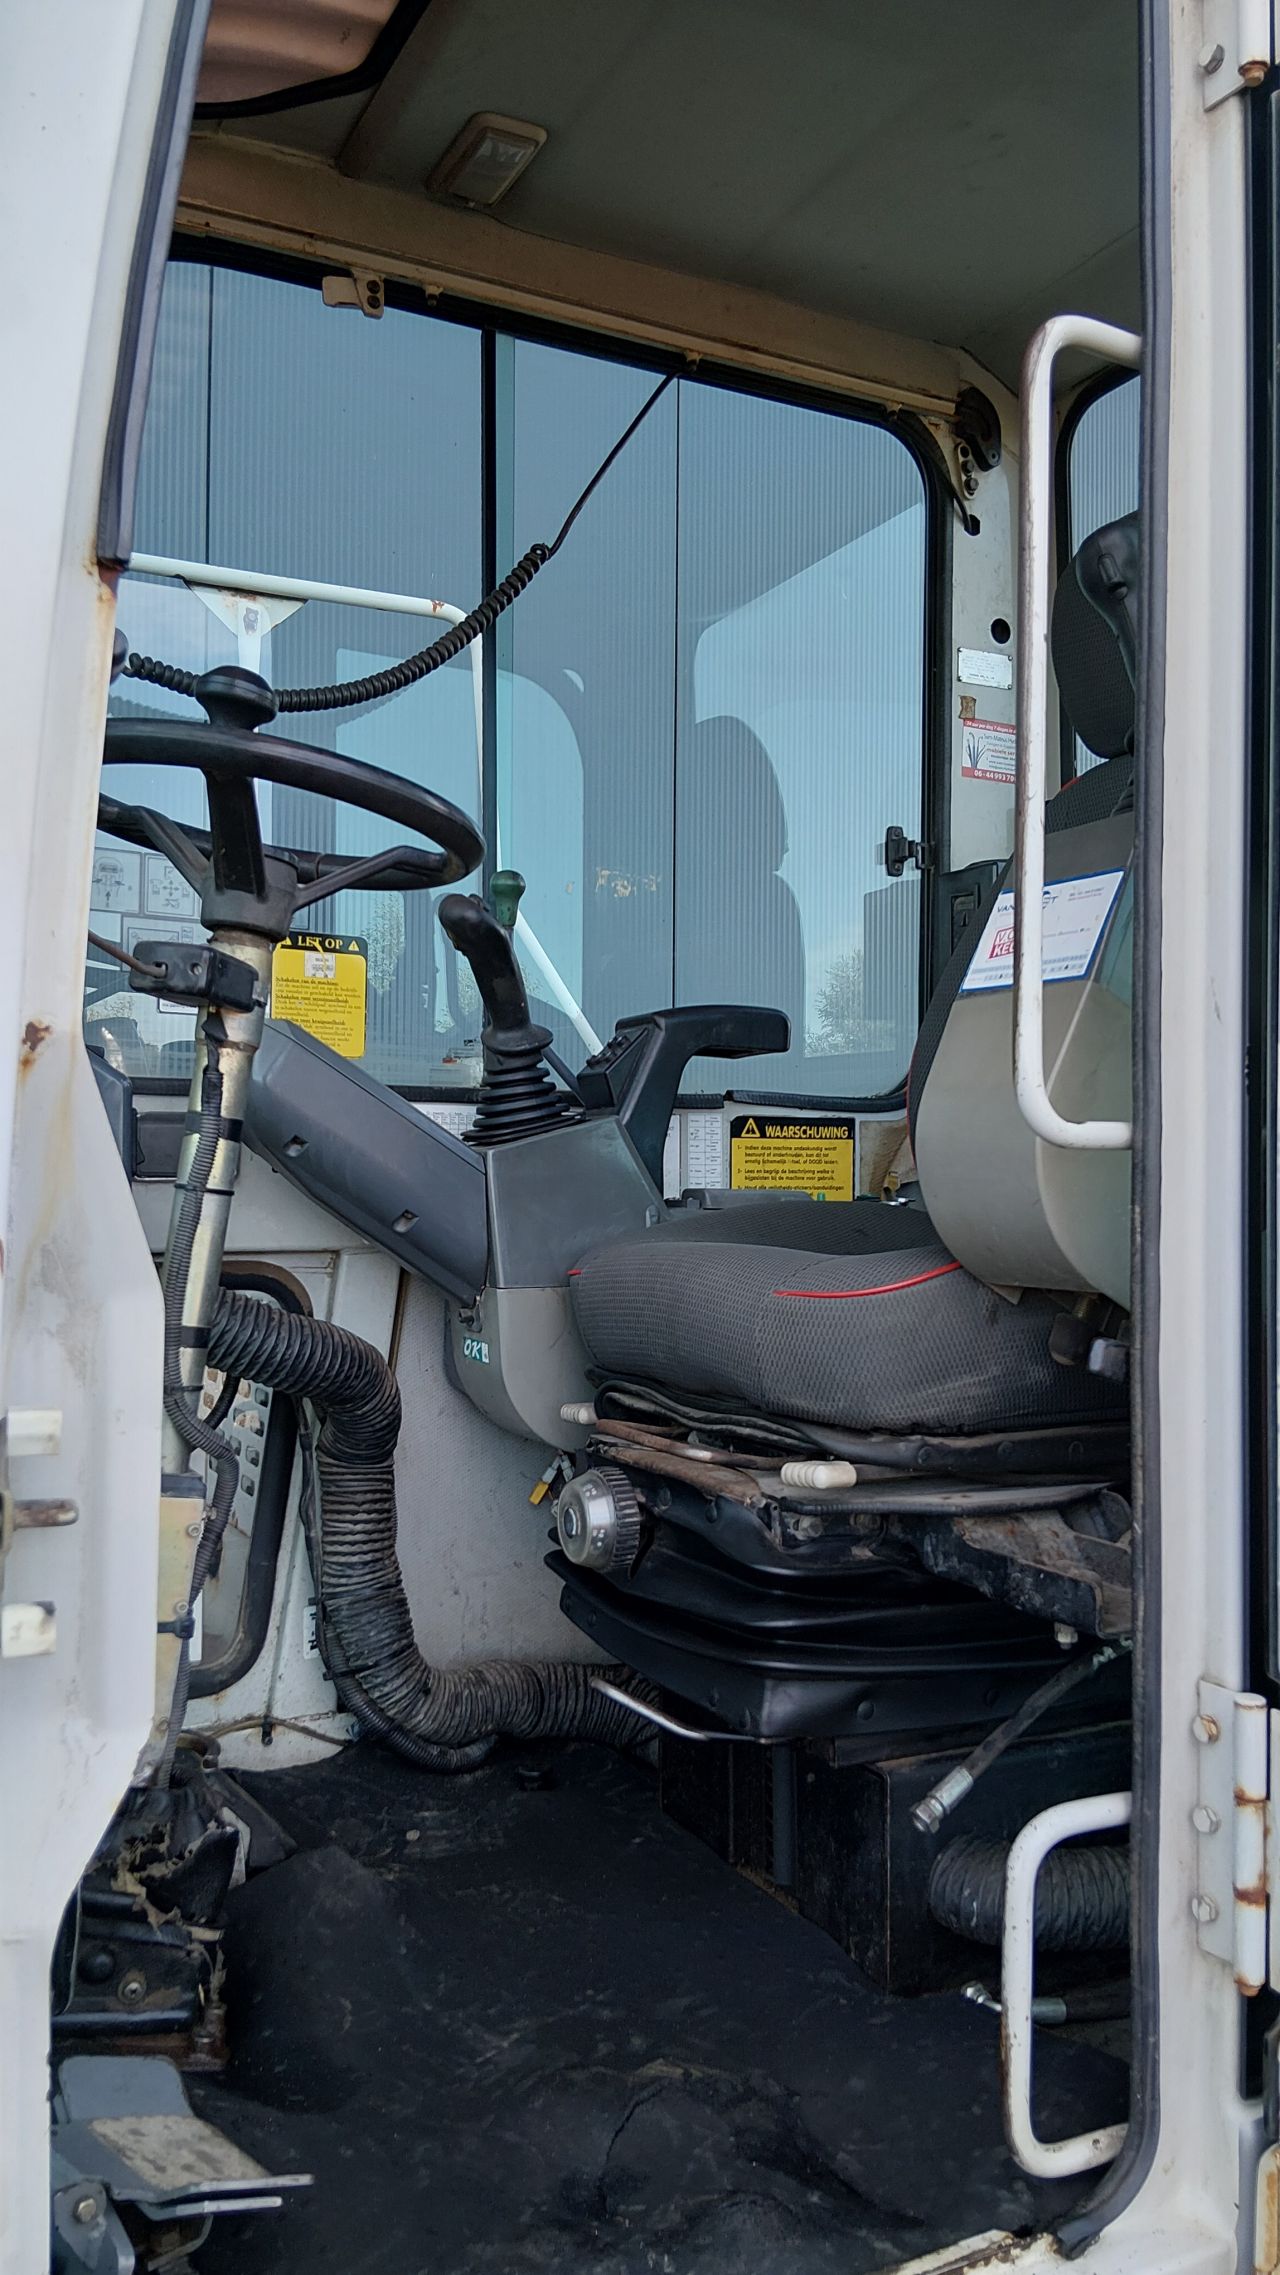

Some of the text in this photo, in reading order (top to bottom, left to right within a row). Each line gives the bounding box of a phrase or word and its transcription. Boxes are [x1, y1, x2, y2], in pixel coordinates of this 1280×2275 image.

[297, 935, 343, 950] LET OP
[765, 1125, 848, 1139] WAARSCHUWING
[463, 1338, 482, 1360] OK
